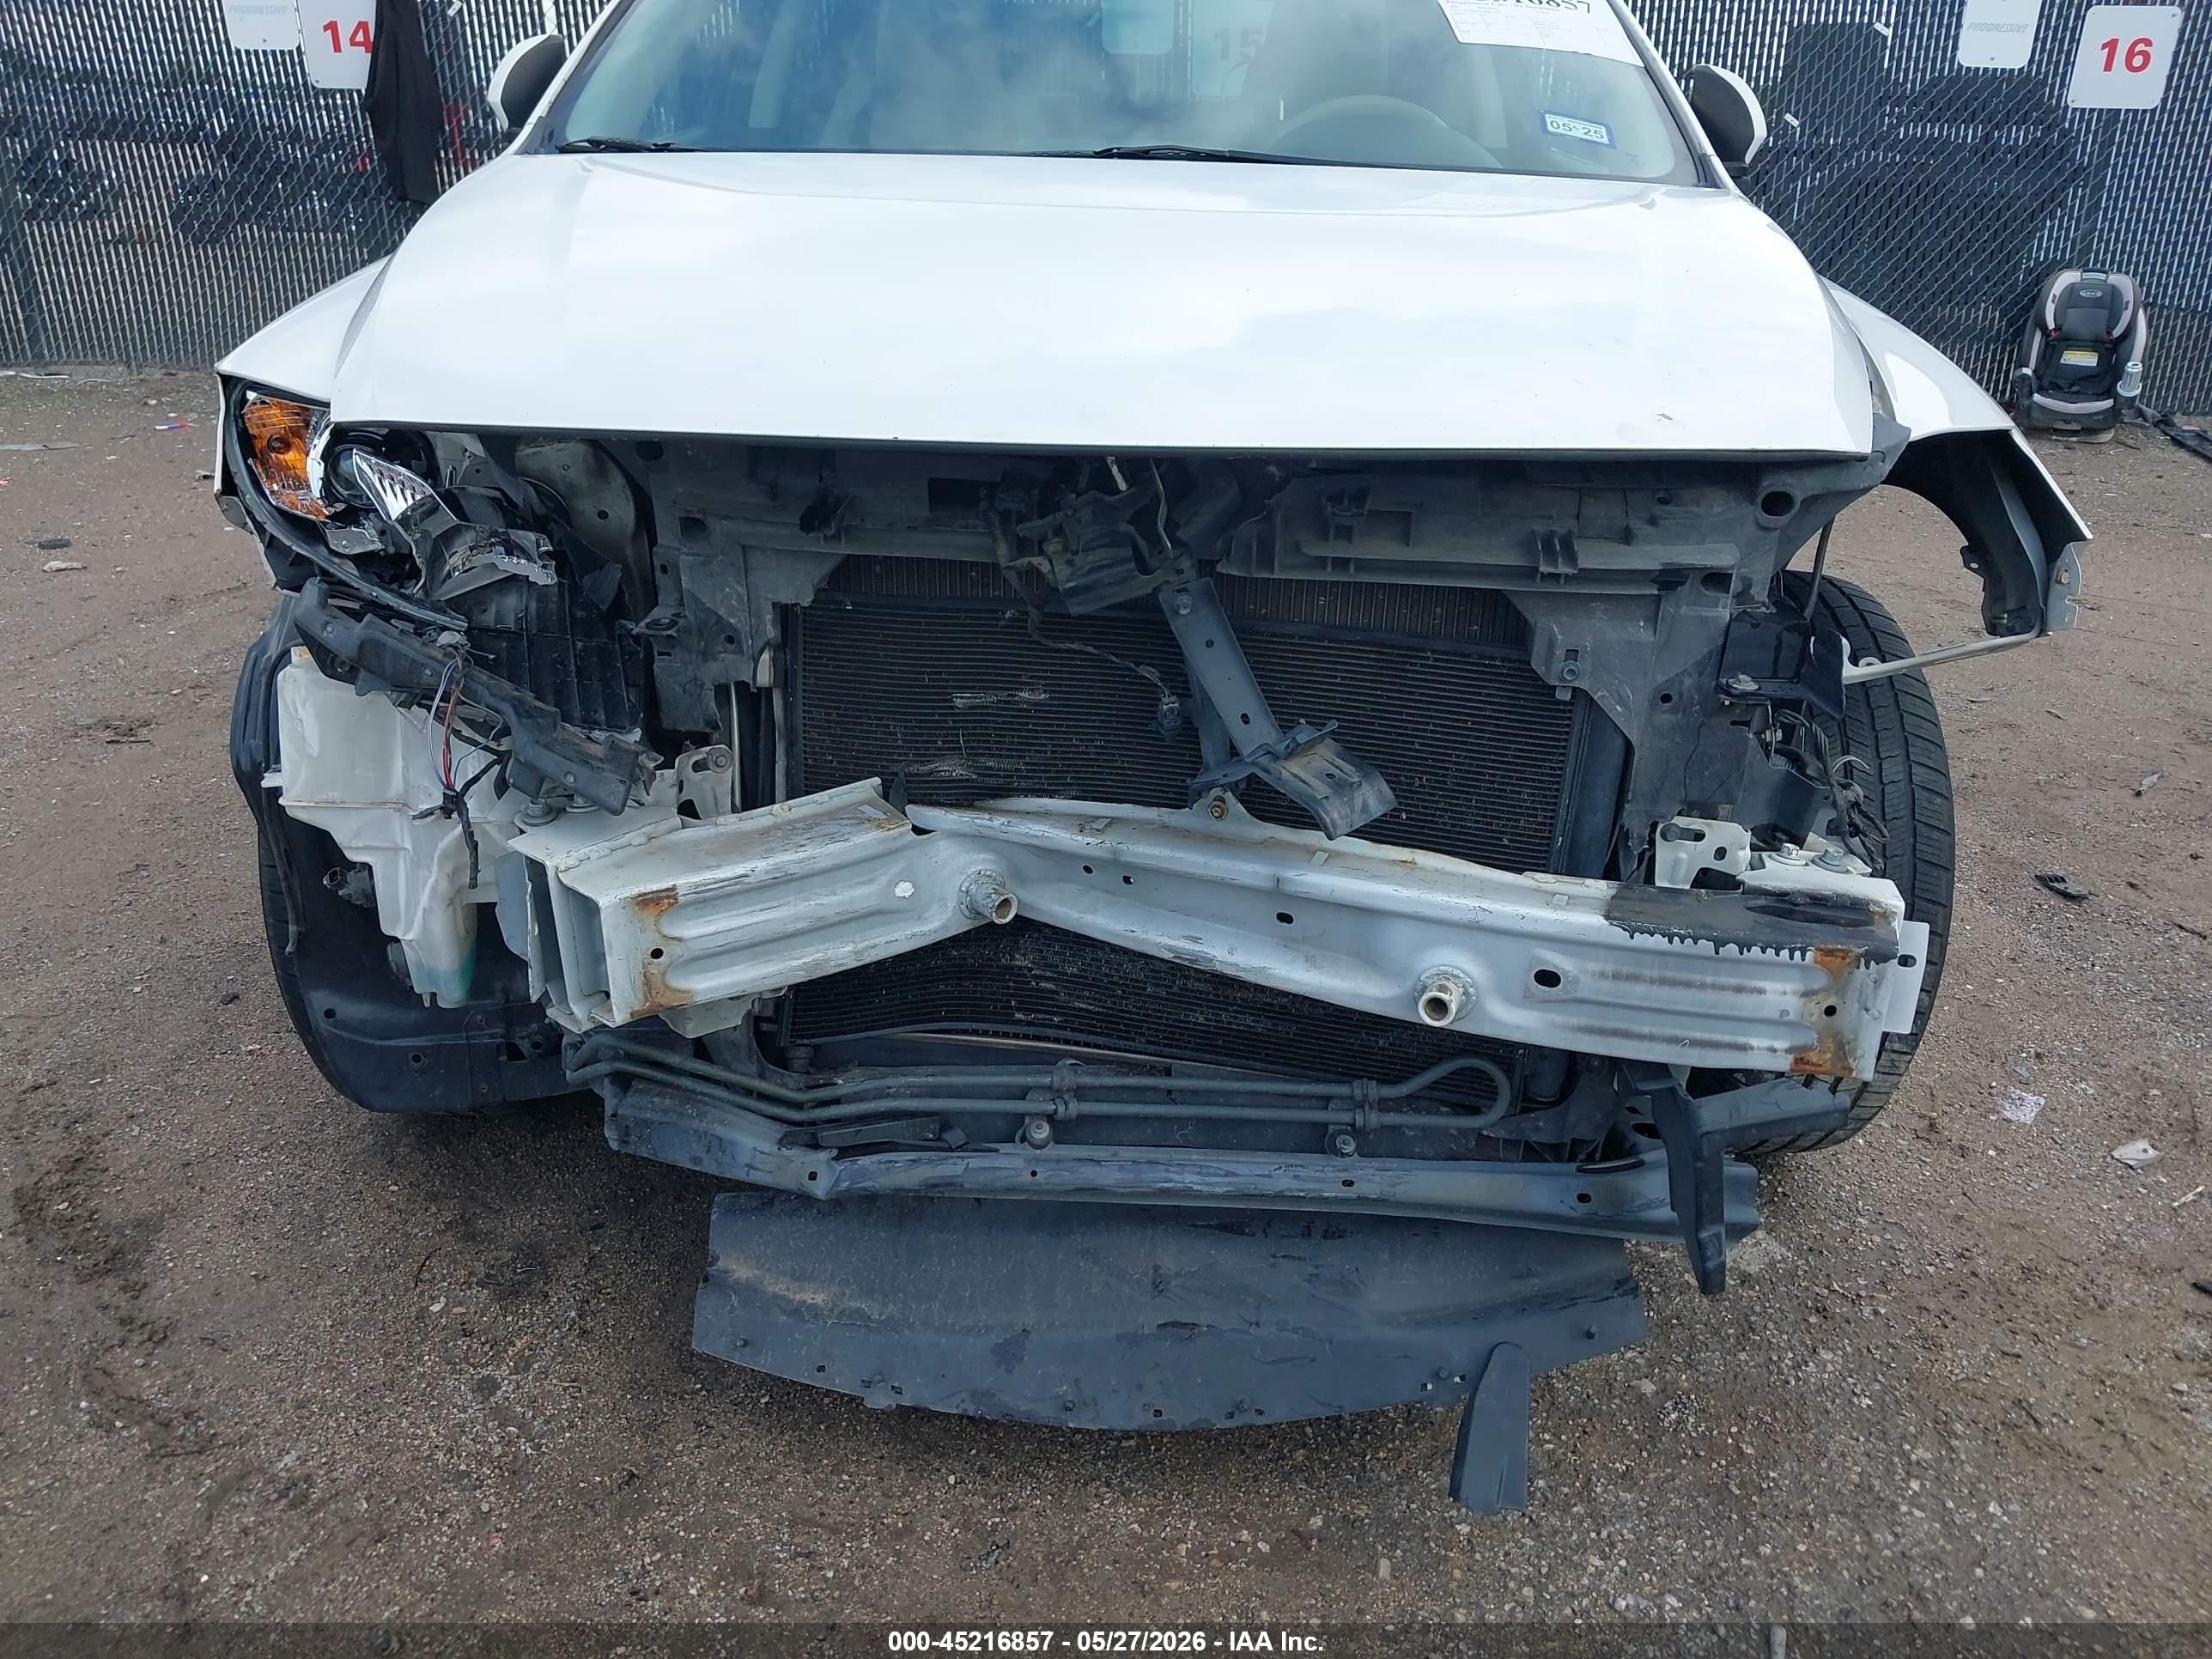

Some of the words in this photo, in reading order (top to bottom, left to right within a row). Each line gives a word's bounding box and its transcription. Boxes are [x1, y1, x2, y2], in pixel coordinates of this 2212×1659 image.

[323, 21, 373, 53] 14
[1213, 27, 1263, 61] 15
[2101, 37, 2153, 73] 16
[1549, 119, 1573, 132] 05
[1582, 126, 1605, 139] 25
